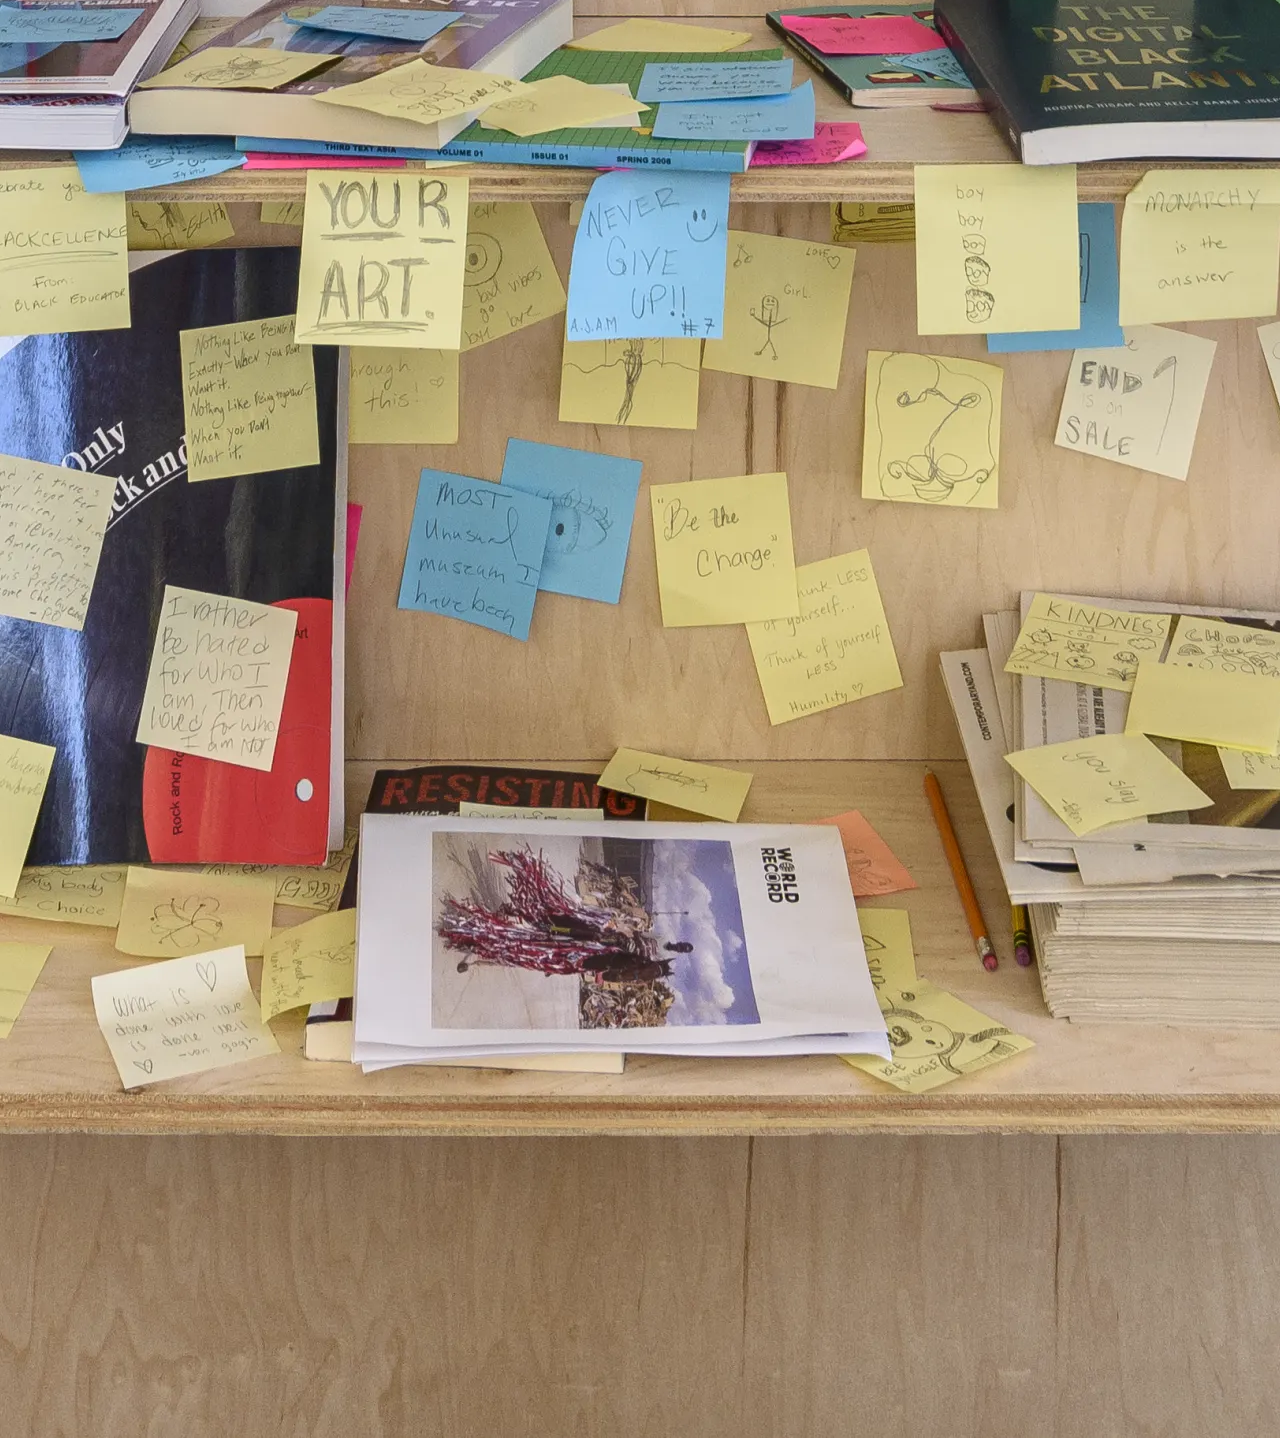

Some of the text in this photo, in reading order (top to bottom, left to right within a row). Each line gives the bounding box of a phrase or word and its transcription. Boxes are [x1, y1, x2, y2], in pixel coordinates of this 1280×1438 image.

[1060, 6, 1170, 20] THE
[1032, 25, 1241, 42] DIGITAL
[1066, 46, 1246, 65] BLACK
[325, 144, 350, 152] THIRD
[352, 145, 374, 153] TEXT
[437, 149, 471, 157] VOLUME
[531, 152, 555, 160] ISSUE
[617, 156, 648, 164] SPRING
[319, 177, 450, 230] YOUR
[586, 188, 680, 238] NEVER
[606, 236, 678, 276] GIVE
[317, 256, 435, 325] ART.
[631, 286, 687, 320] UP!!
[1046, 600, 1167, 636] KINDNESS
[381, 774, 637, 817] RESISTING
